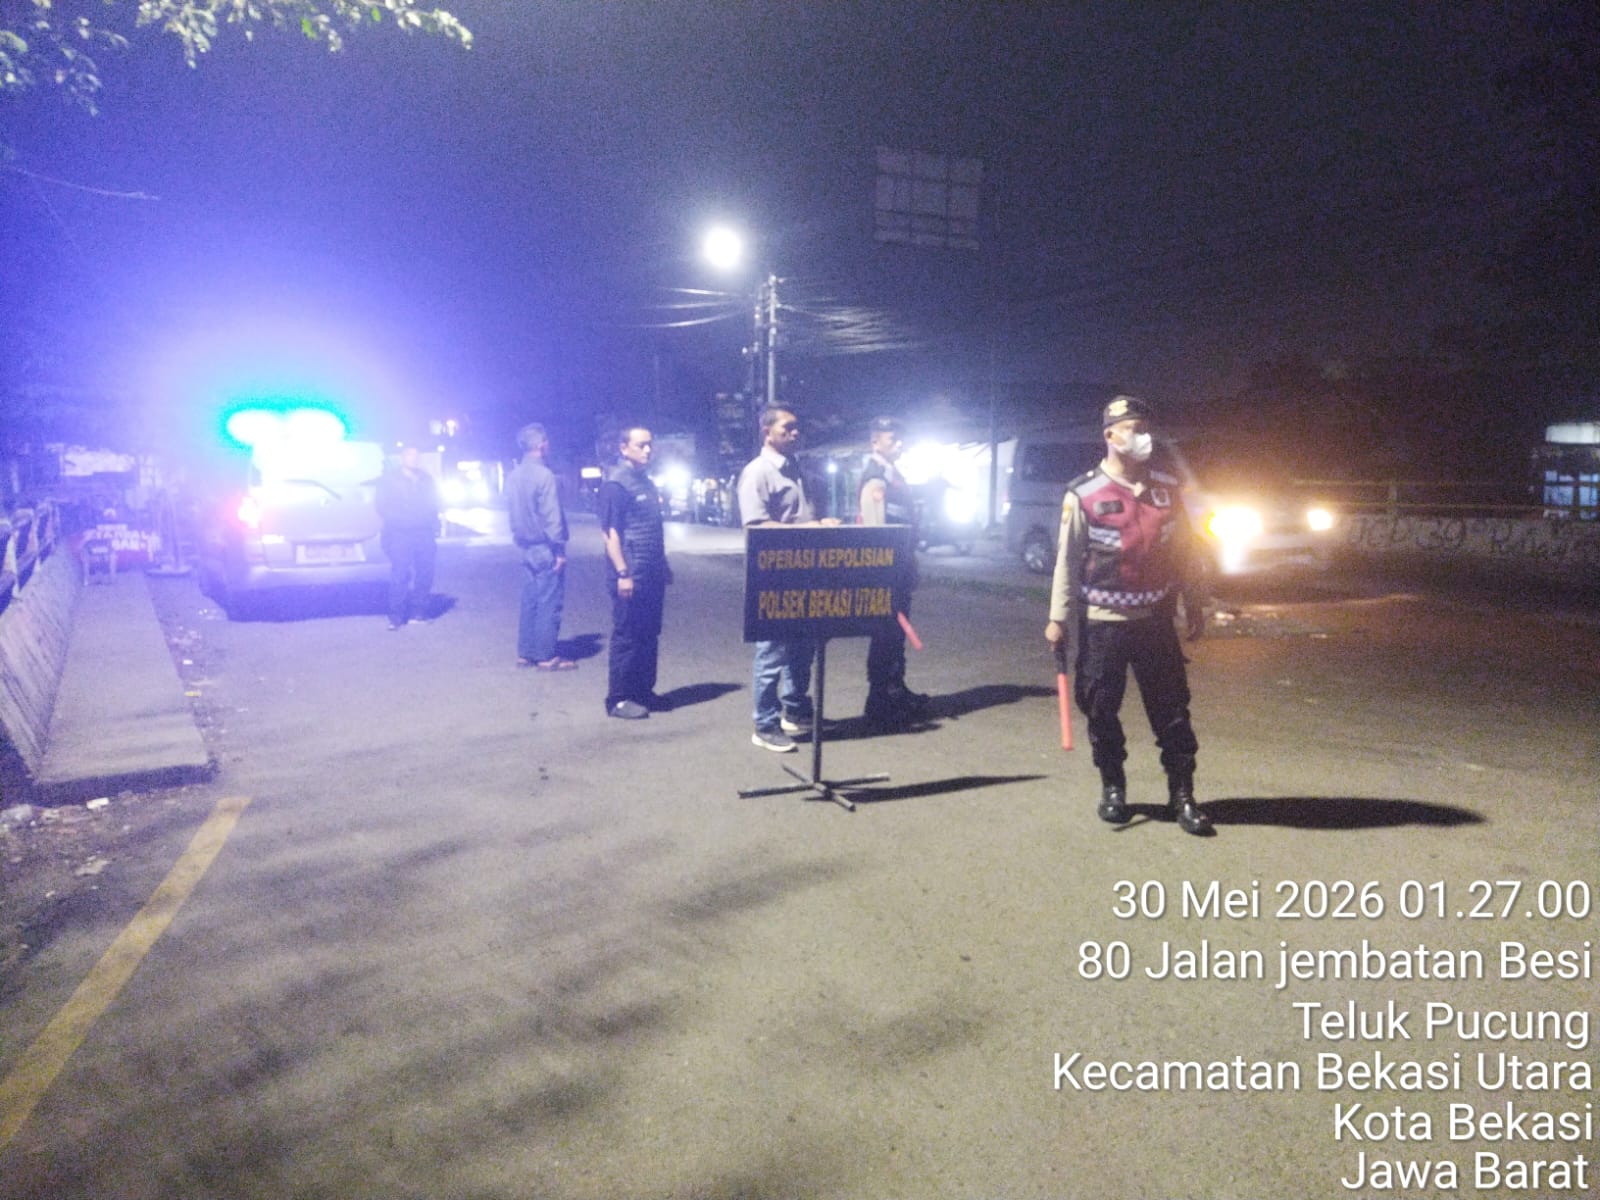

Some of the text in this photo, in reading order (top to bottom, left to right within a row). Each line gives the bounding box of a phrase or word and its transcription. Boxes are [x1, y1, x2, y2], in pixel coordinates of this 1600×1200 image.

[758, 547, 895, 570] OPERASI KEPOLISIAN
[758, 586, 892, 619] POLSEK BEKASI UTARA
